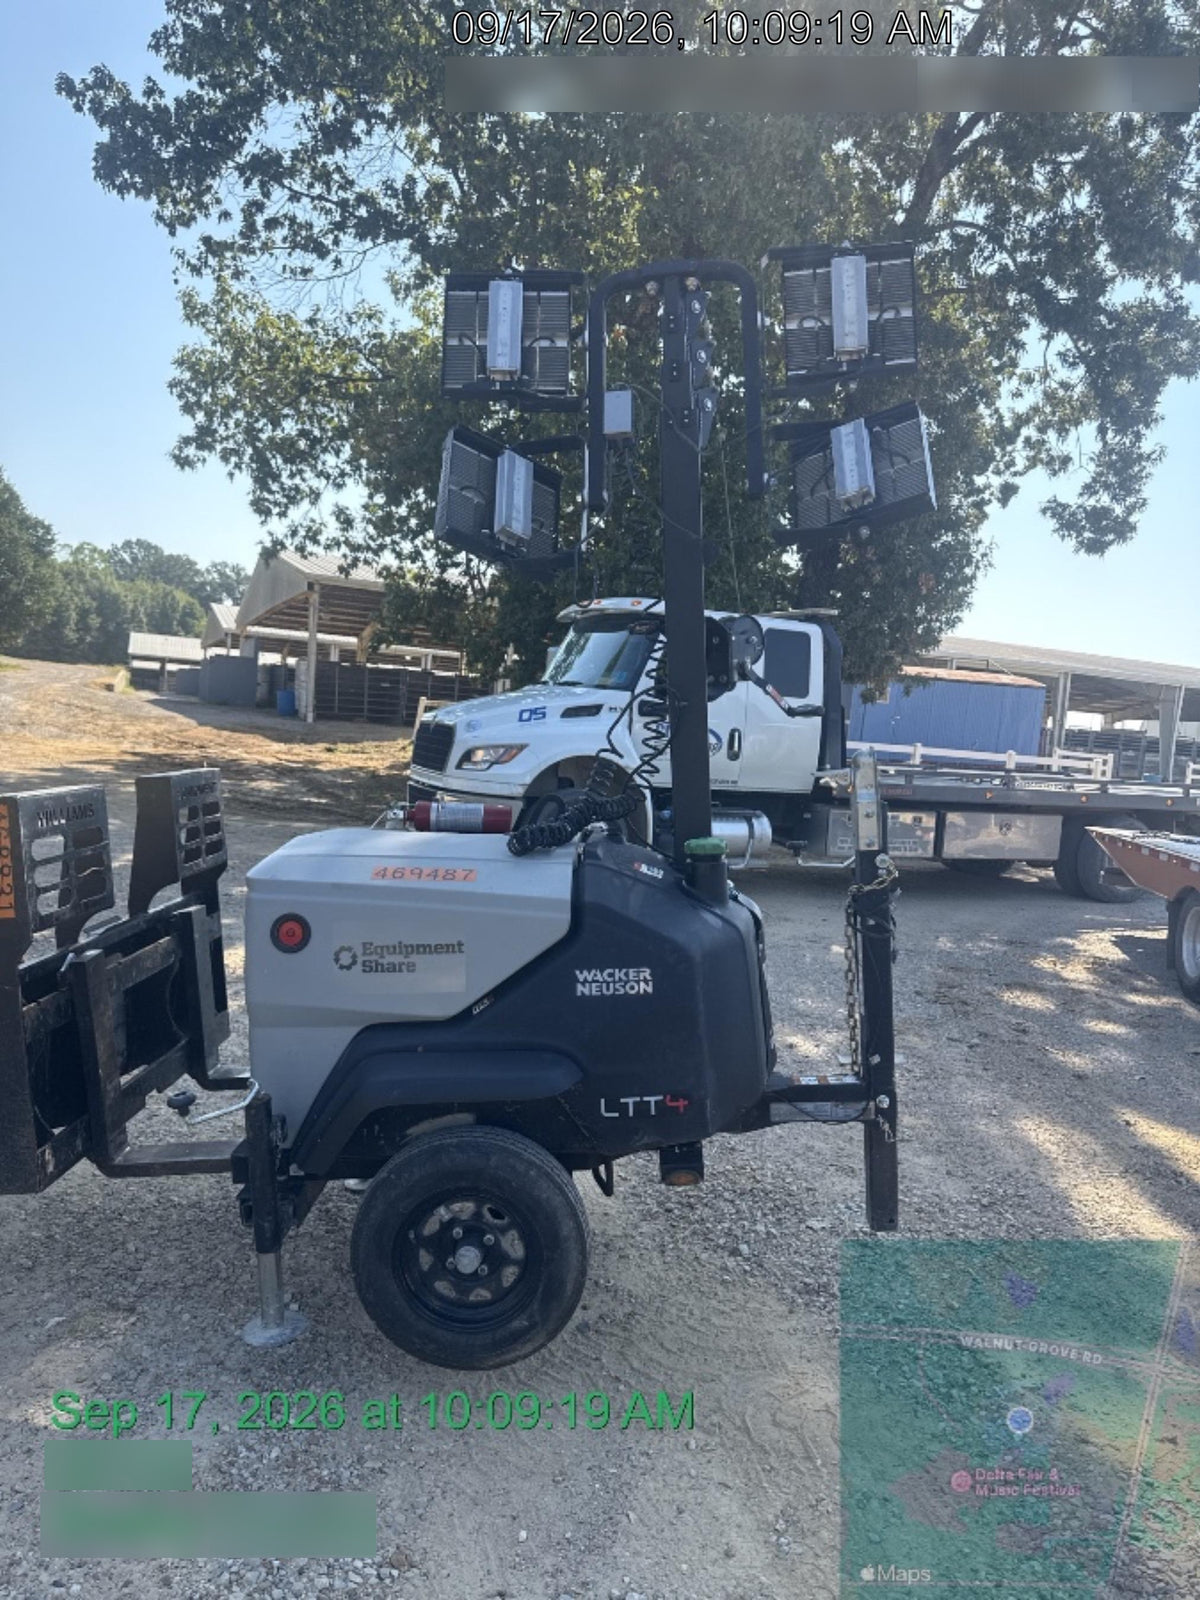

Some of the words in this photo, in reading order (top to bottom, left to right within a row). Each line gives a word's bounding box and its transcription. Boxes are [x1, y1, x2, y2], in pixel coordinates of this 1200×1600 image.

[374, 866, 475, 881] 469487
[361, 940, 465, 959] Equipment
[361, 960, 416, 974] Share
[574, 967, 653, 982] WACKER
[575, 981, 654, 997] NEUSON
[600, 1095, 690, 1118] LTT4
